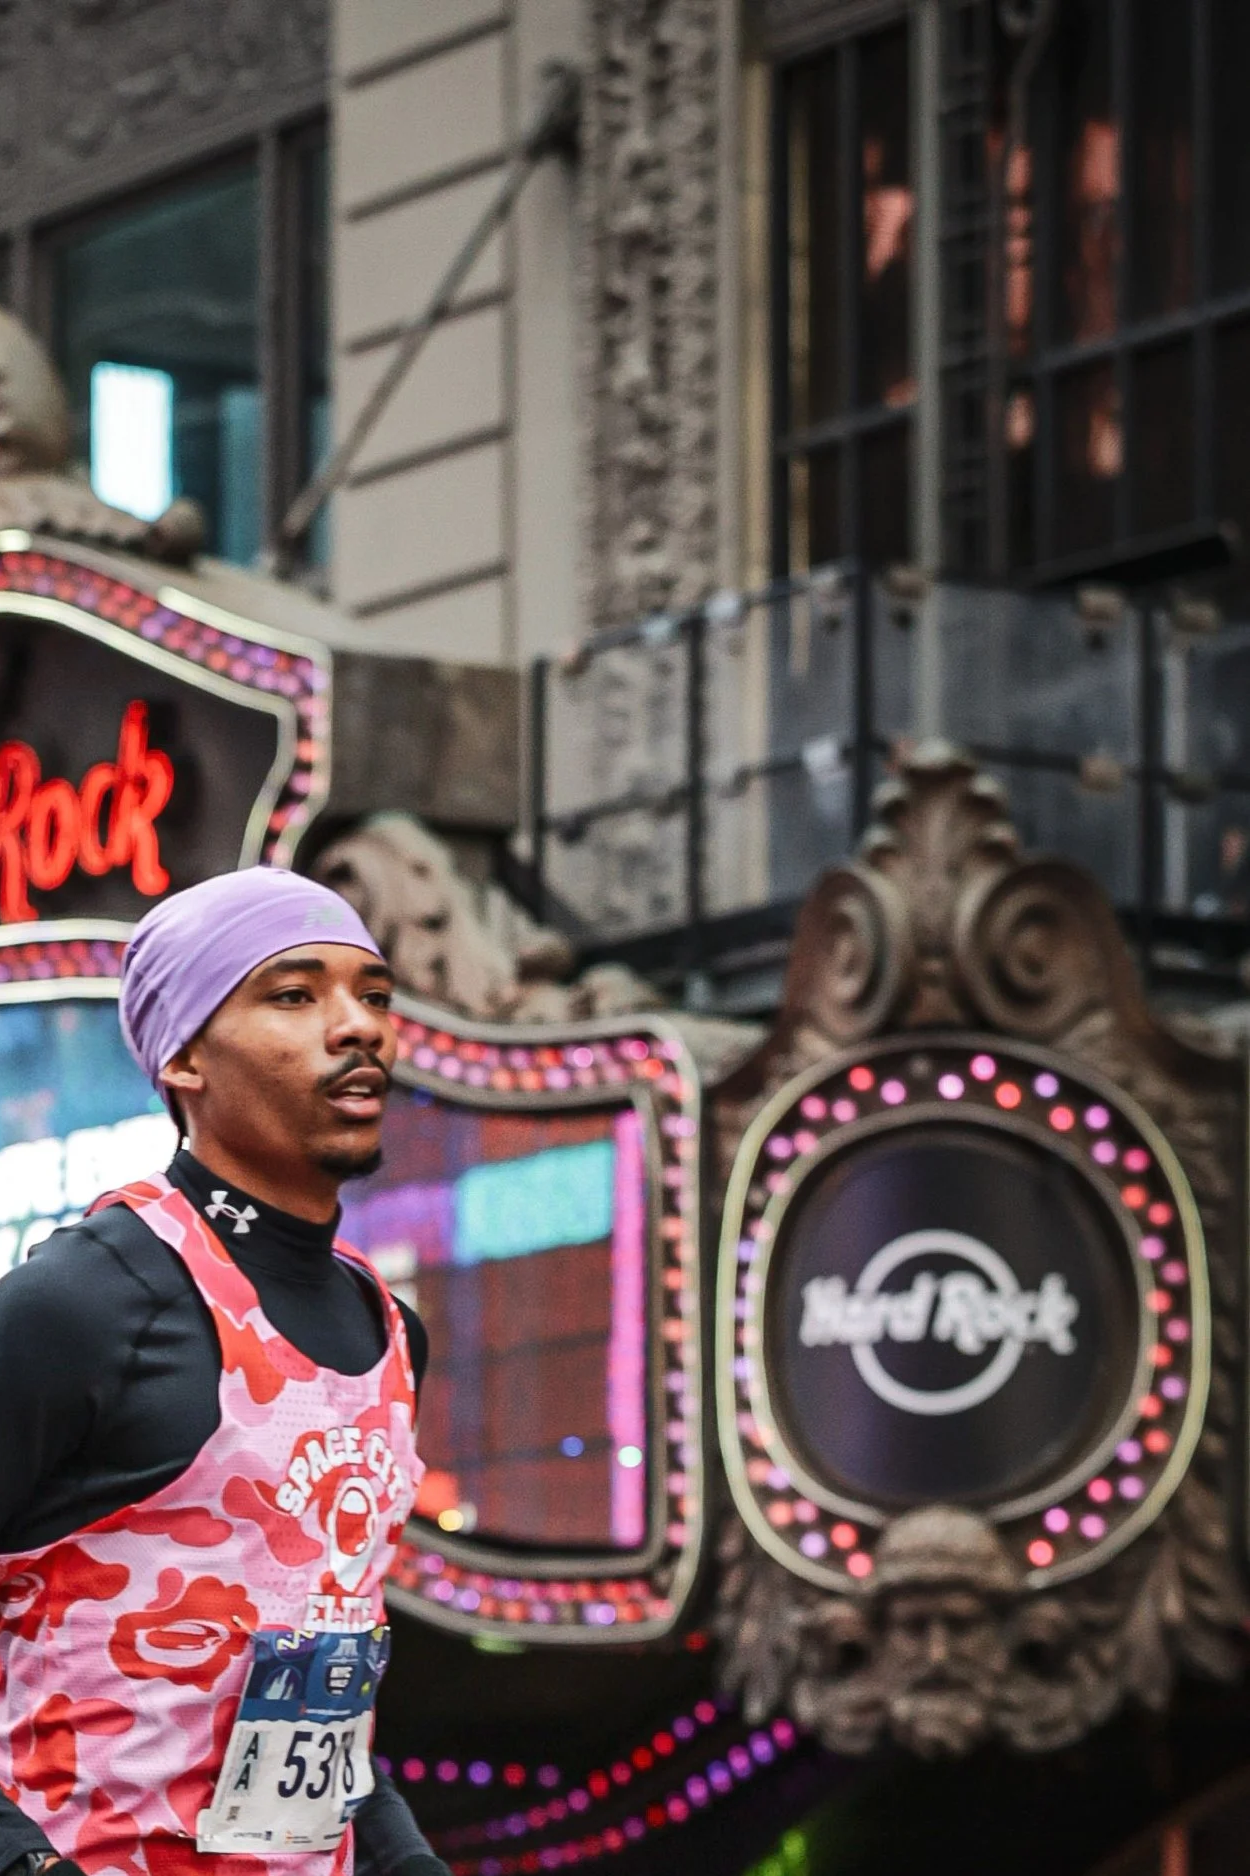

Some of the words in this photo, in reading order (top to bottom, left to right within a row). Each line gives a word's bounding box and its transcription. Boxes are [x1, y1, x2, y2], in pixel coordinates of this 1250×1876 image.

[799, 1271, 937, 1347] Hard
[931, 1270, 1080, 1355] Rock
[275, 1425, 365, 1518] SPACE
[302, 1593, 377, 1634] ELITE
